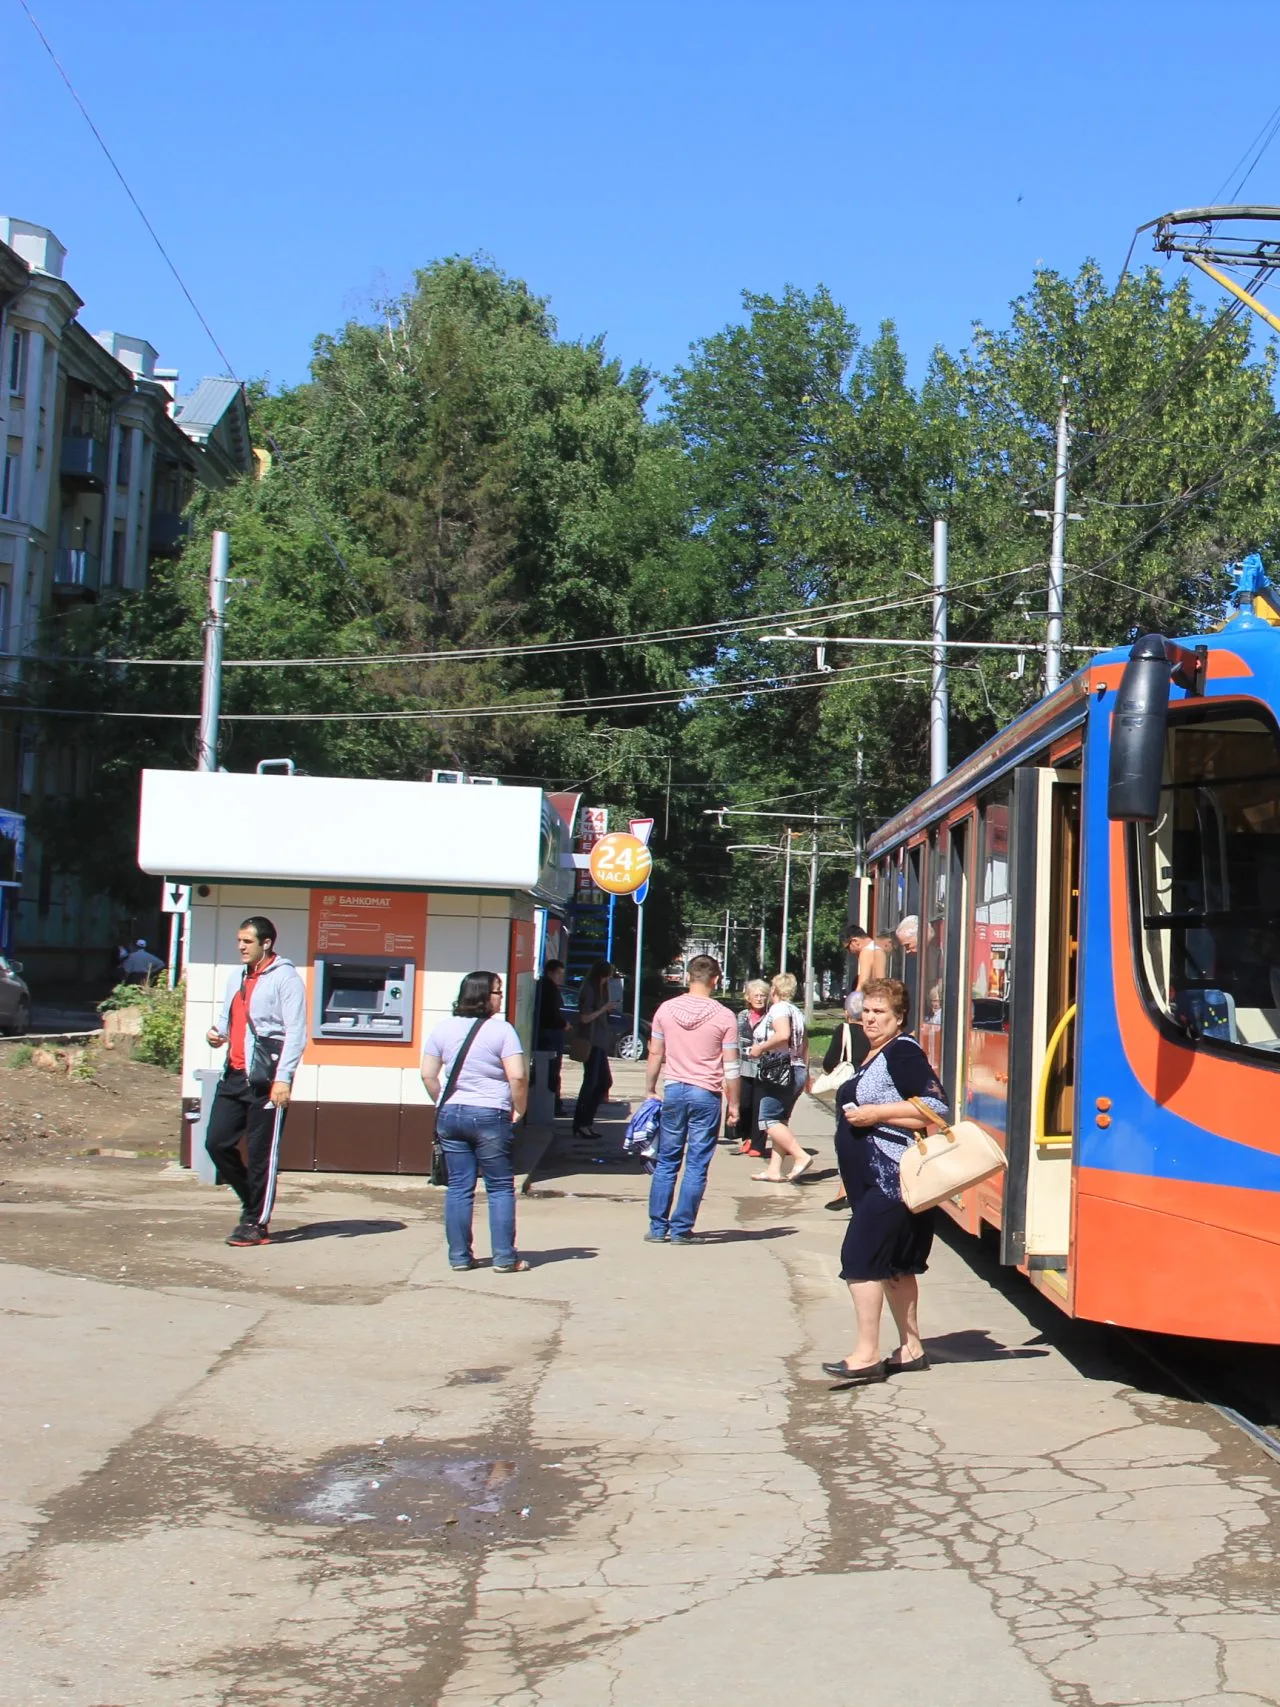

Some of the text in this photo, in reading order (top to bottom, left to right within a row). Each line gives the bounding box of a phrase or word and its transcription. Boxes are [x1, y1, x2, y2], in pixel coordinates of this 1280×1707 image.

[585, 810, 605, 823] 24
[598, 845, 633, 870] 24
[596, 870, 632, 883] ЧАСА
[339, 895, 391, 906] БАНКОМАТ
